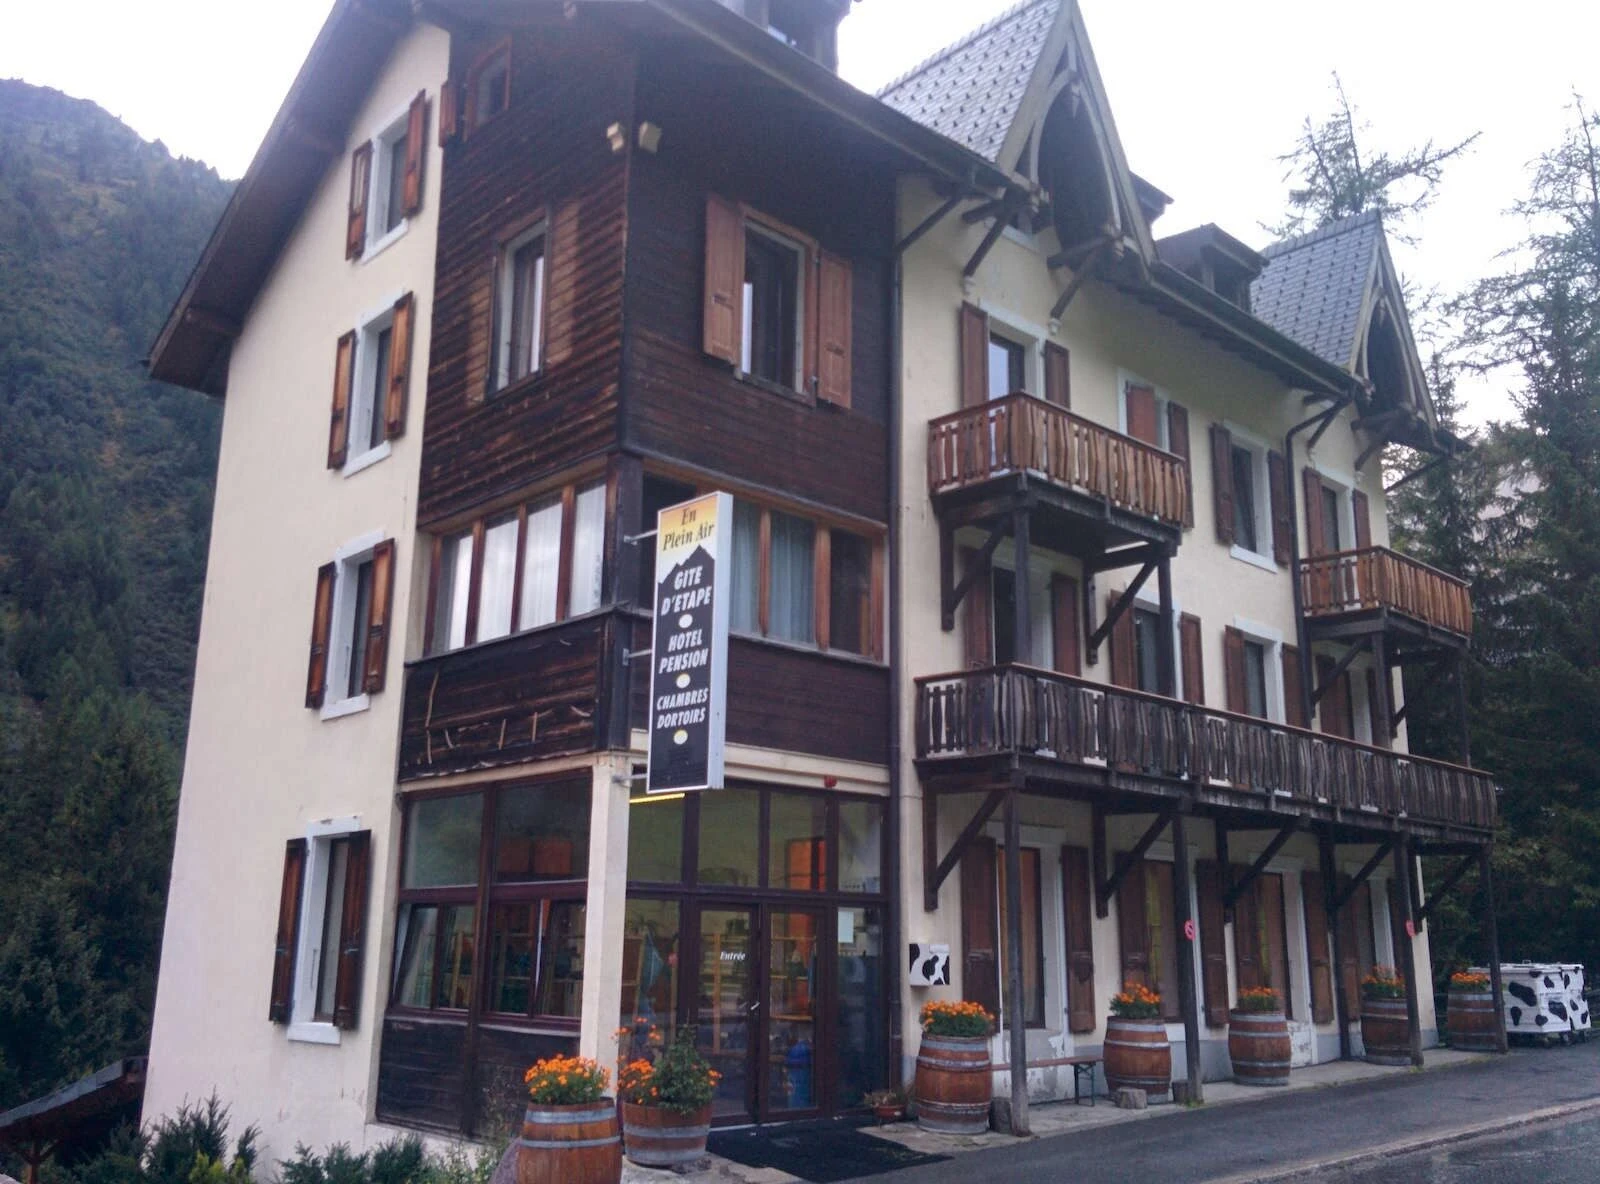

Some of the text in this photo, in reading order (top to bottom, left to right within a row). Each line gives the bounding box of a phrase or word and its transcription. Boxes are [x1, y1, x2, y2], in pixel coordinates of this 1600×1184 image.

[681, 507, 697, 526] En
[662, 522, 715, 551] Plein Air
[674, 565, 703, 590] GITE
[661, 586, 713, 617] D'ETAPE
[667, 629, 703, 652] HOTEL
[658, 648, 709, 674] PENSION
[656, 687, 709, 711] CHAMBRES
[656, 708, 706, 730] DORTOIRS
